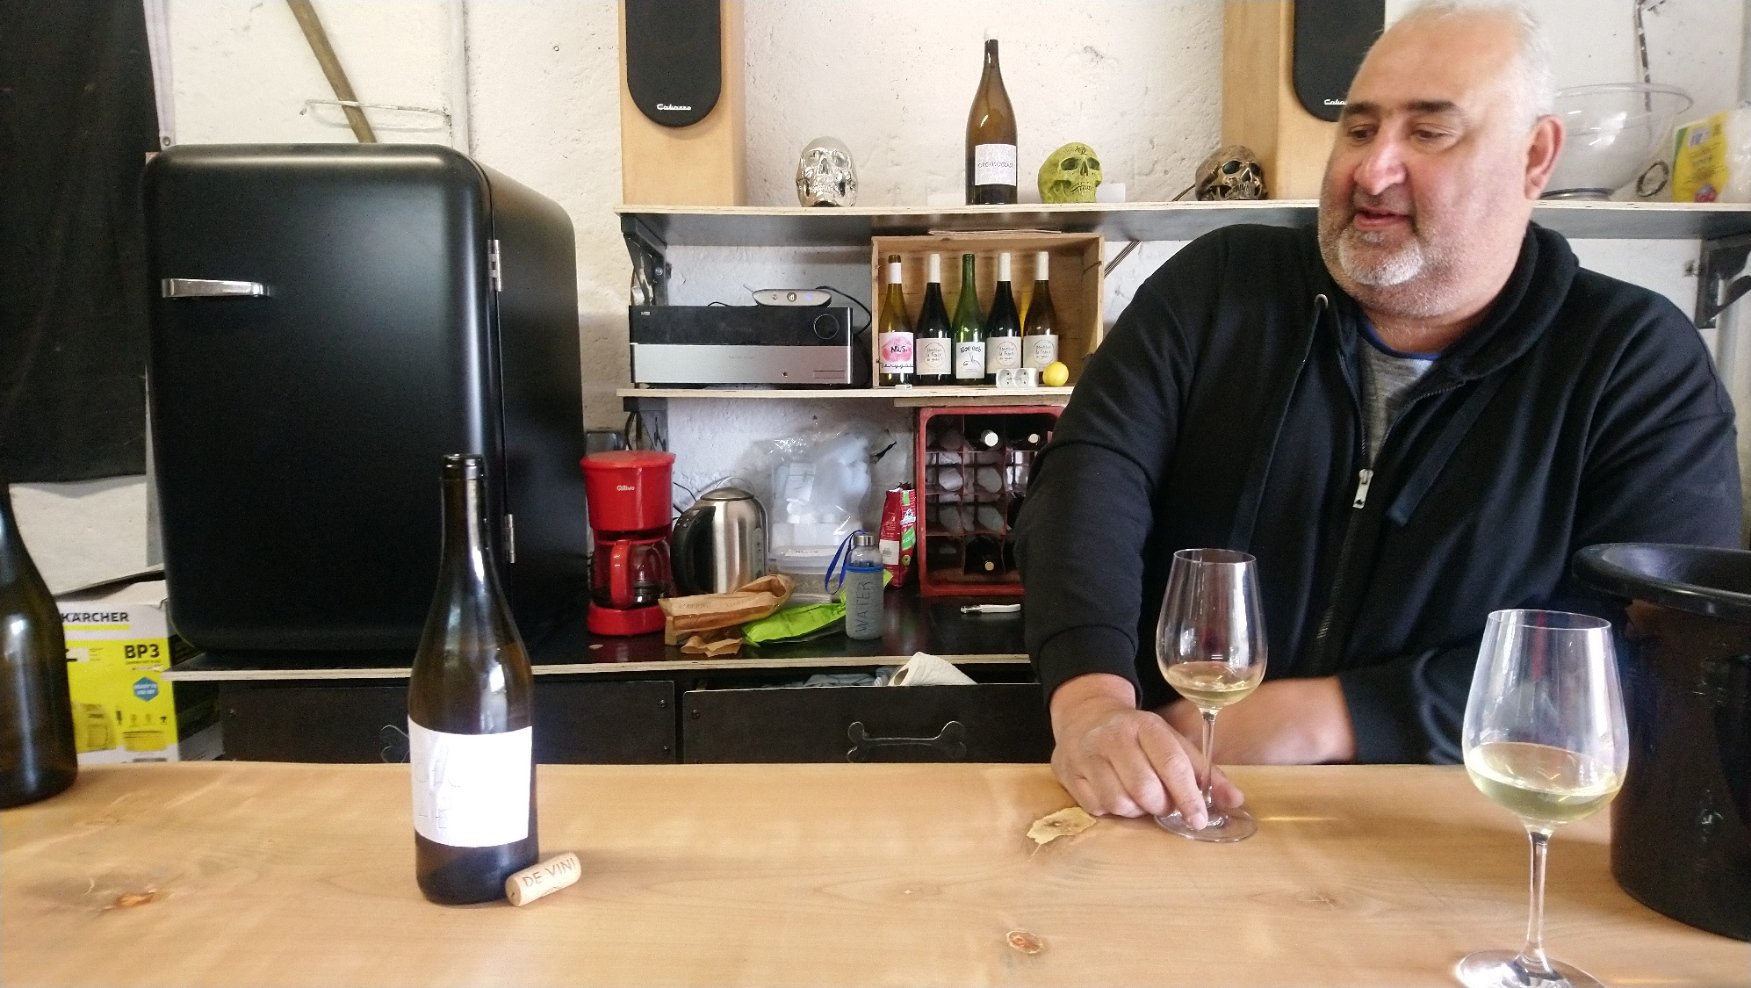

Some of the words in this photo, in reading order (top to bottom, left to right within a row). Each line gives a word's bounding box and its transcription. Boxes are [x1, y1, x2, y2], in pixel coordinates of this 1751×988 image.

[855, 581, 872, 632] WATER
[522, 871, 543, 887] DE
[544, 857, 576, 877] VINI
